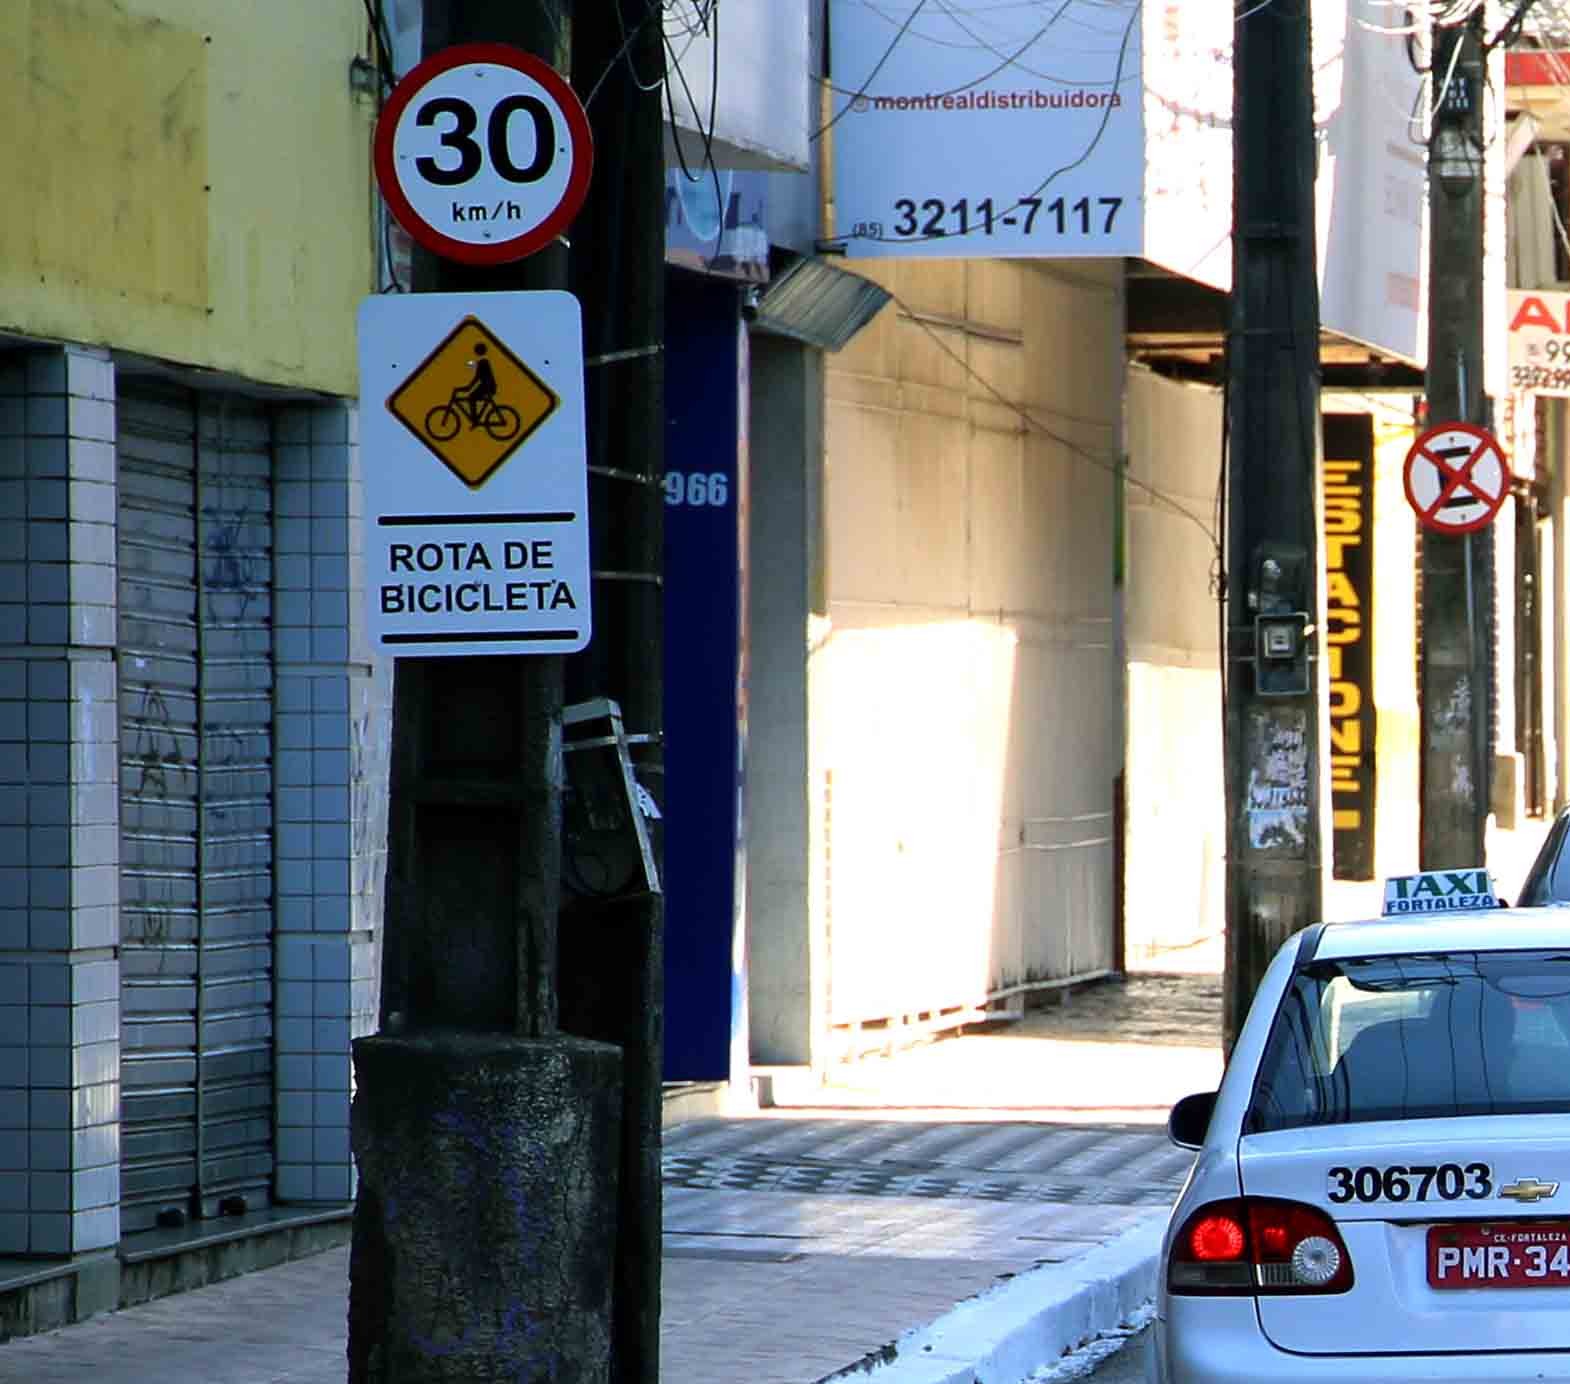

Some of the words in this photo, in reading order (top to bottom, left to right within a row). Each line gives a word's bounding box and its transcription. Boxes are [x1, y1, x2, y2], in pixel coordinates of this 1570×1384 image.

[874, 90, 1121, 111] montrealdistribuidora
[414, 94, 556, 187] 30
[451, 200, 522, 223] km/h
[851, 221, 883, 239] (85)
[894, 196, 1122, 237] 3211-7117
[664, 471, 729, 507] 966
[389, 542, 492, 573] ROTA
[503, 540, 554, 570] DE
[380, 580, 577, 614] BICICLETA
[1386, 871, 1489, 898] TAXI
[1386, 895, 1494, 913] FORTALEZA
[1328, 1163, 1493, 1204] 306703
